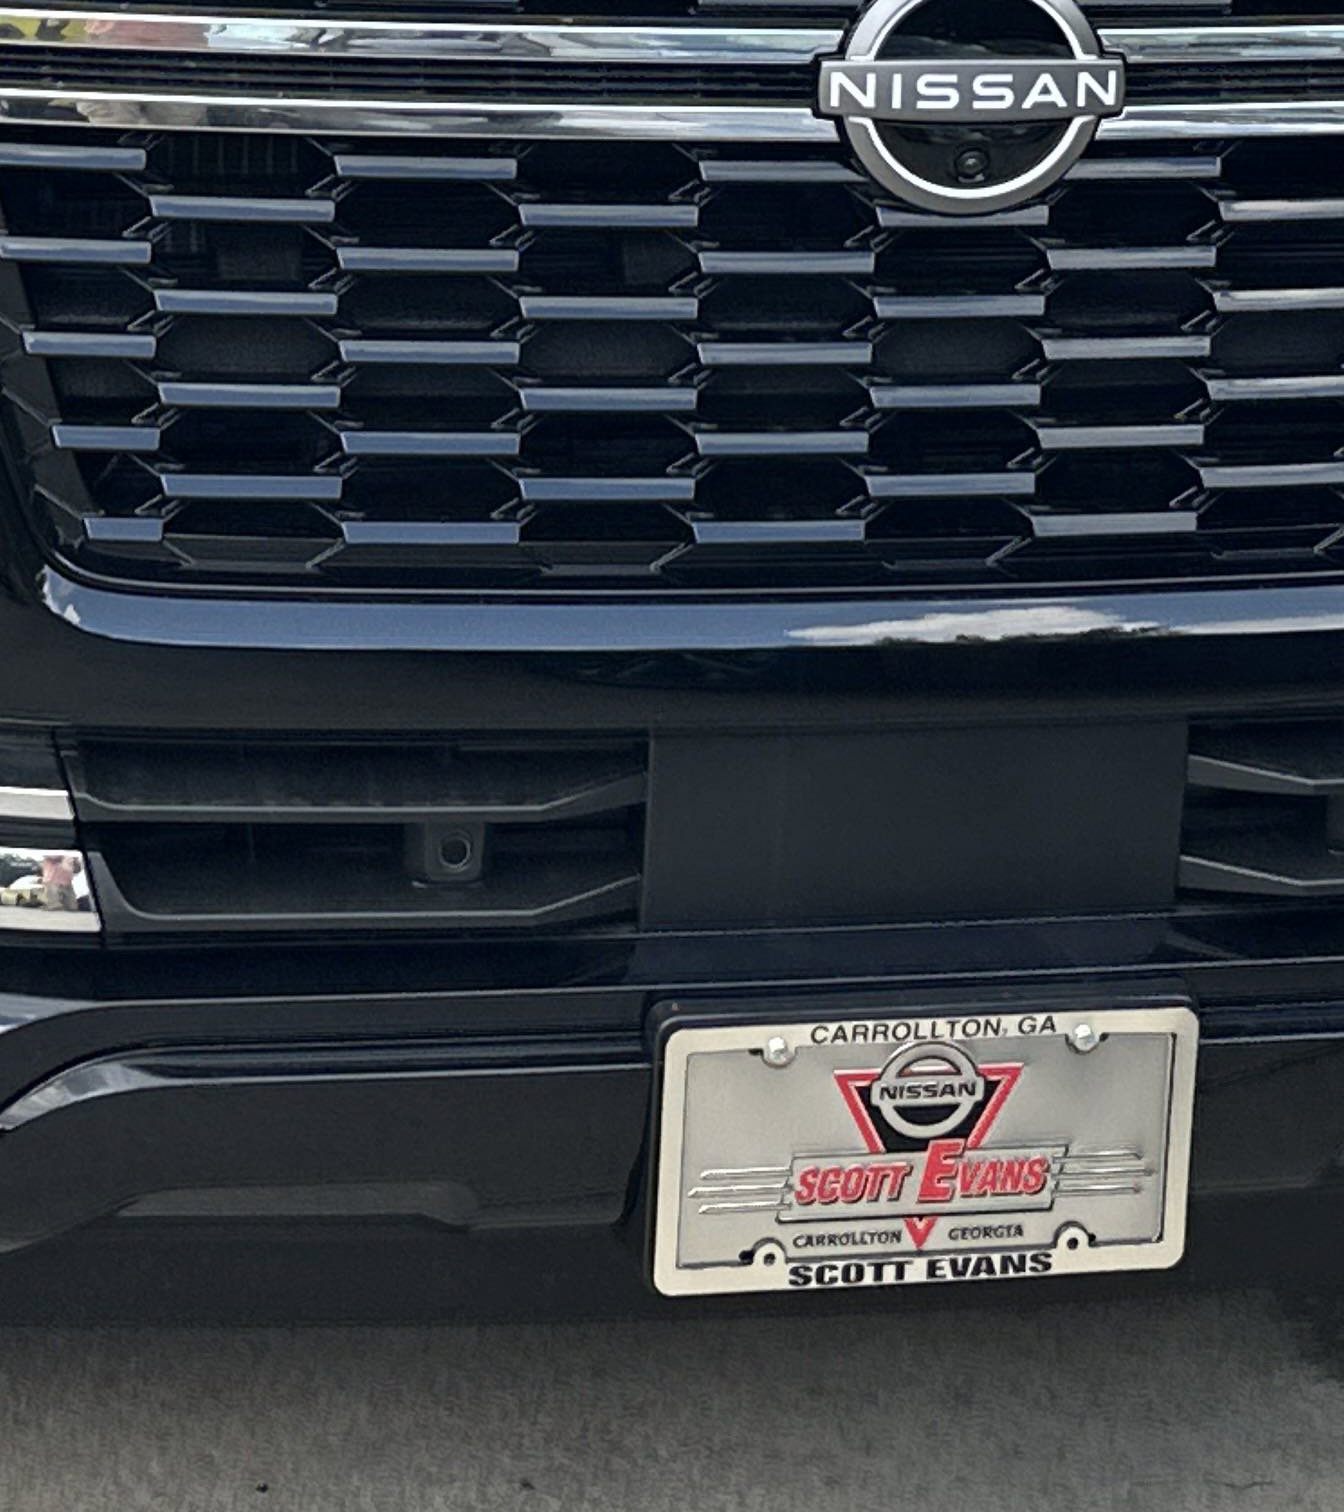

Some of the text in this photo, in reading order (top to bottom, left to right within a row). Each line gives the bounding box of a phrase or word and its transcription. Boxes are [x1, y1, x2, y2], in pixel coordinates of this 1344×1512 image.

[829, 70, 1117, 110] NISSAN
[1018, 1015, 1056, 1036] GA
[878, 1081, 977, 1101] NISSAN
[794, 1140, 1049, 1205] SCOTT EVANS
[793, 1223, 1024, 1249] CARROLLTON GEORGIA
[788, 1252, 1052, 1287] SCOTT EVANS
